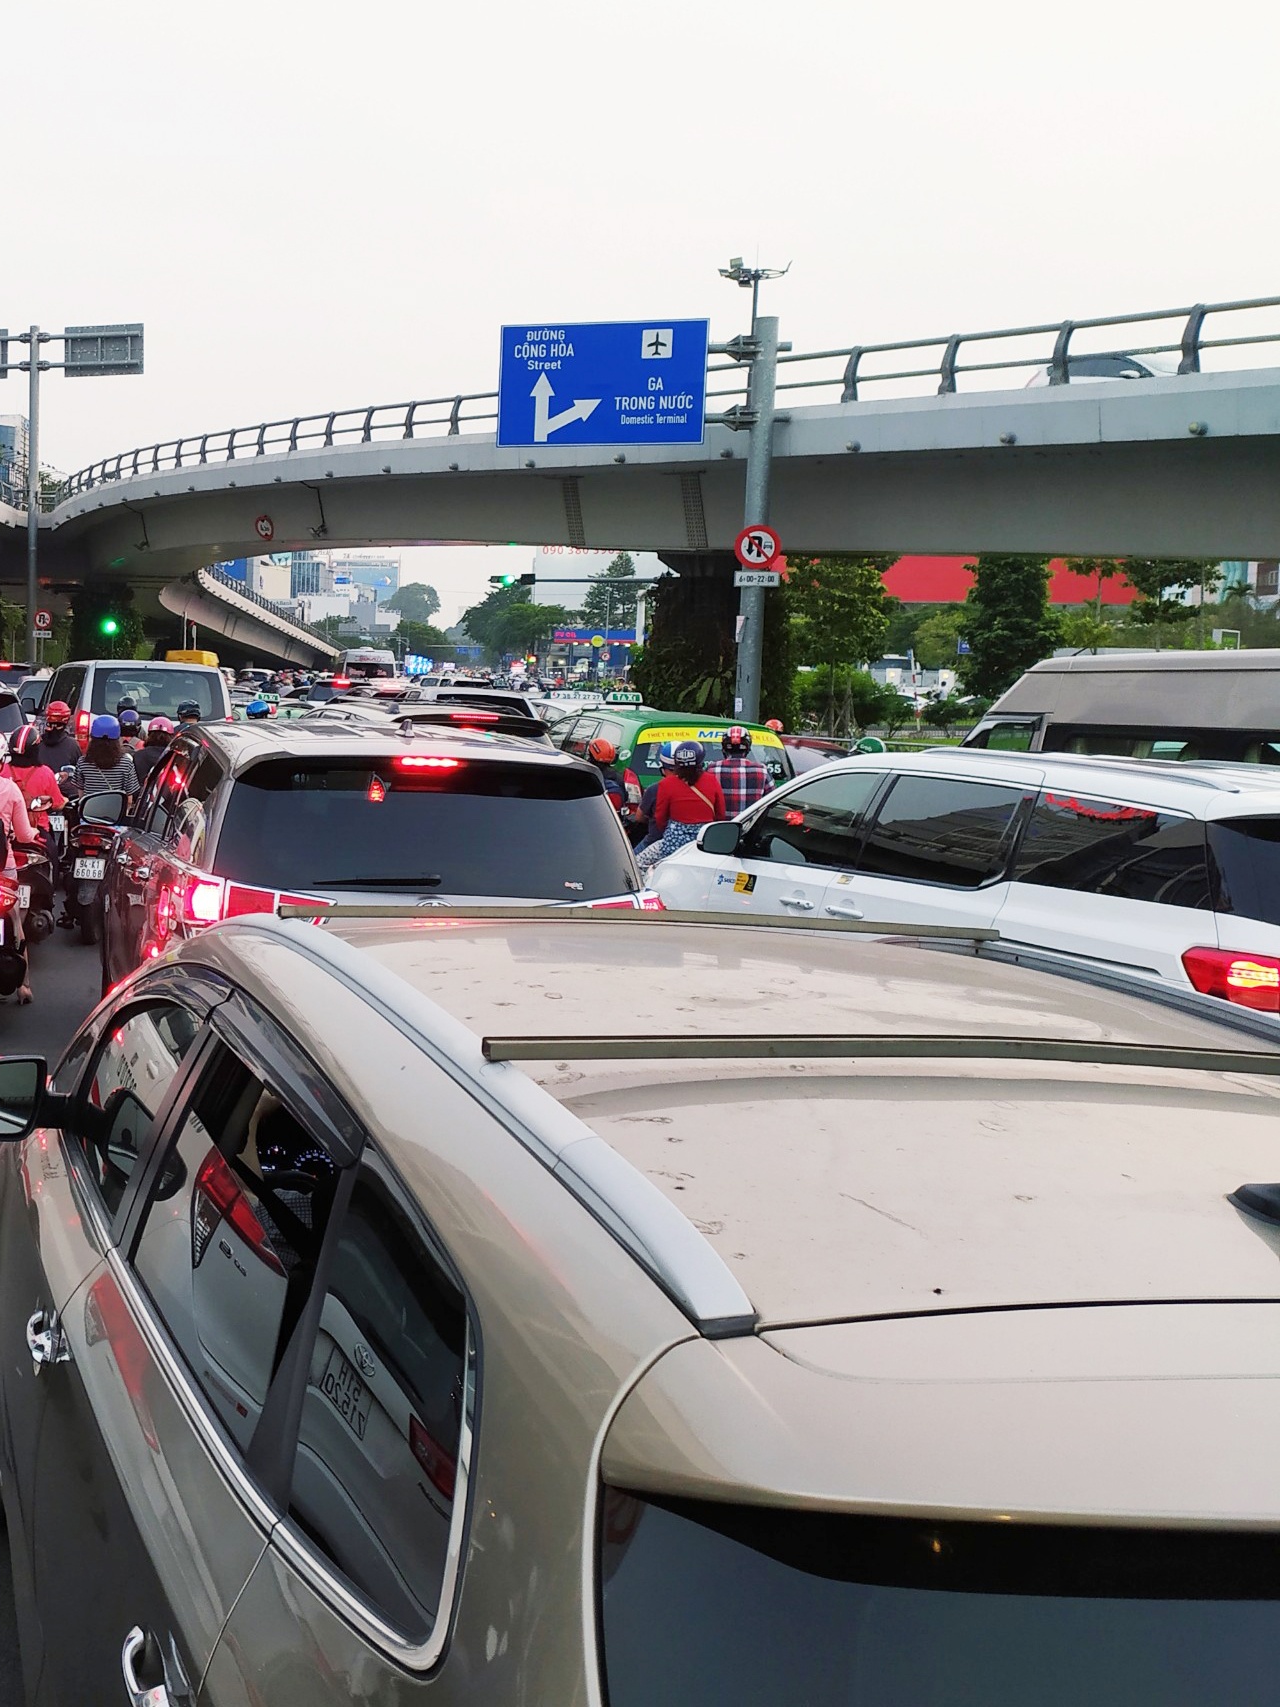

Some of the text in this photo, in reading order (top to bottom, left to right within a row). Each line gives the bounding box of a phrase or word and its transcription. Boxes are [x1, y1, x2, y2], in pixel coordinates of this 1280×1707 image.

[526, 328, 566, 341] ĐƯỜNG
[514, 341, 575, 360] CỘNG HÒA
[527, 360, 562, 370] Street
[647, 376, 664, 391] GA
[614, 391, 694, 410] TRONG NƯỚC
[620, 413, 687, 425] Domestic Terminal
